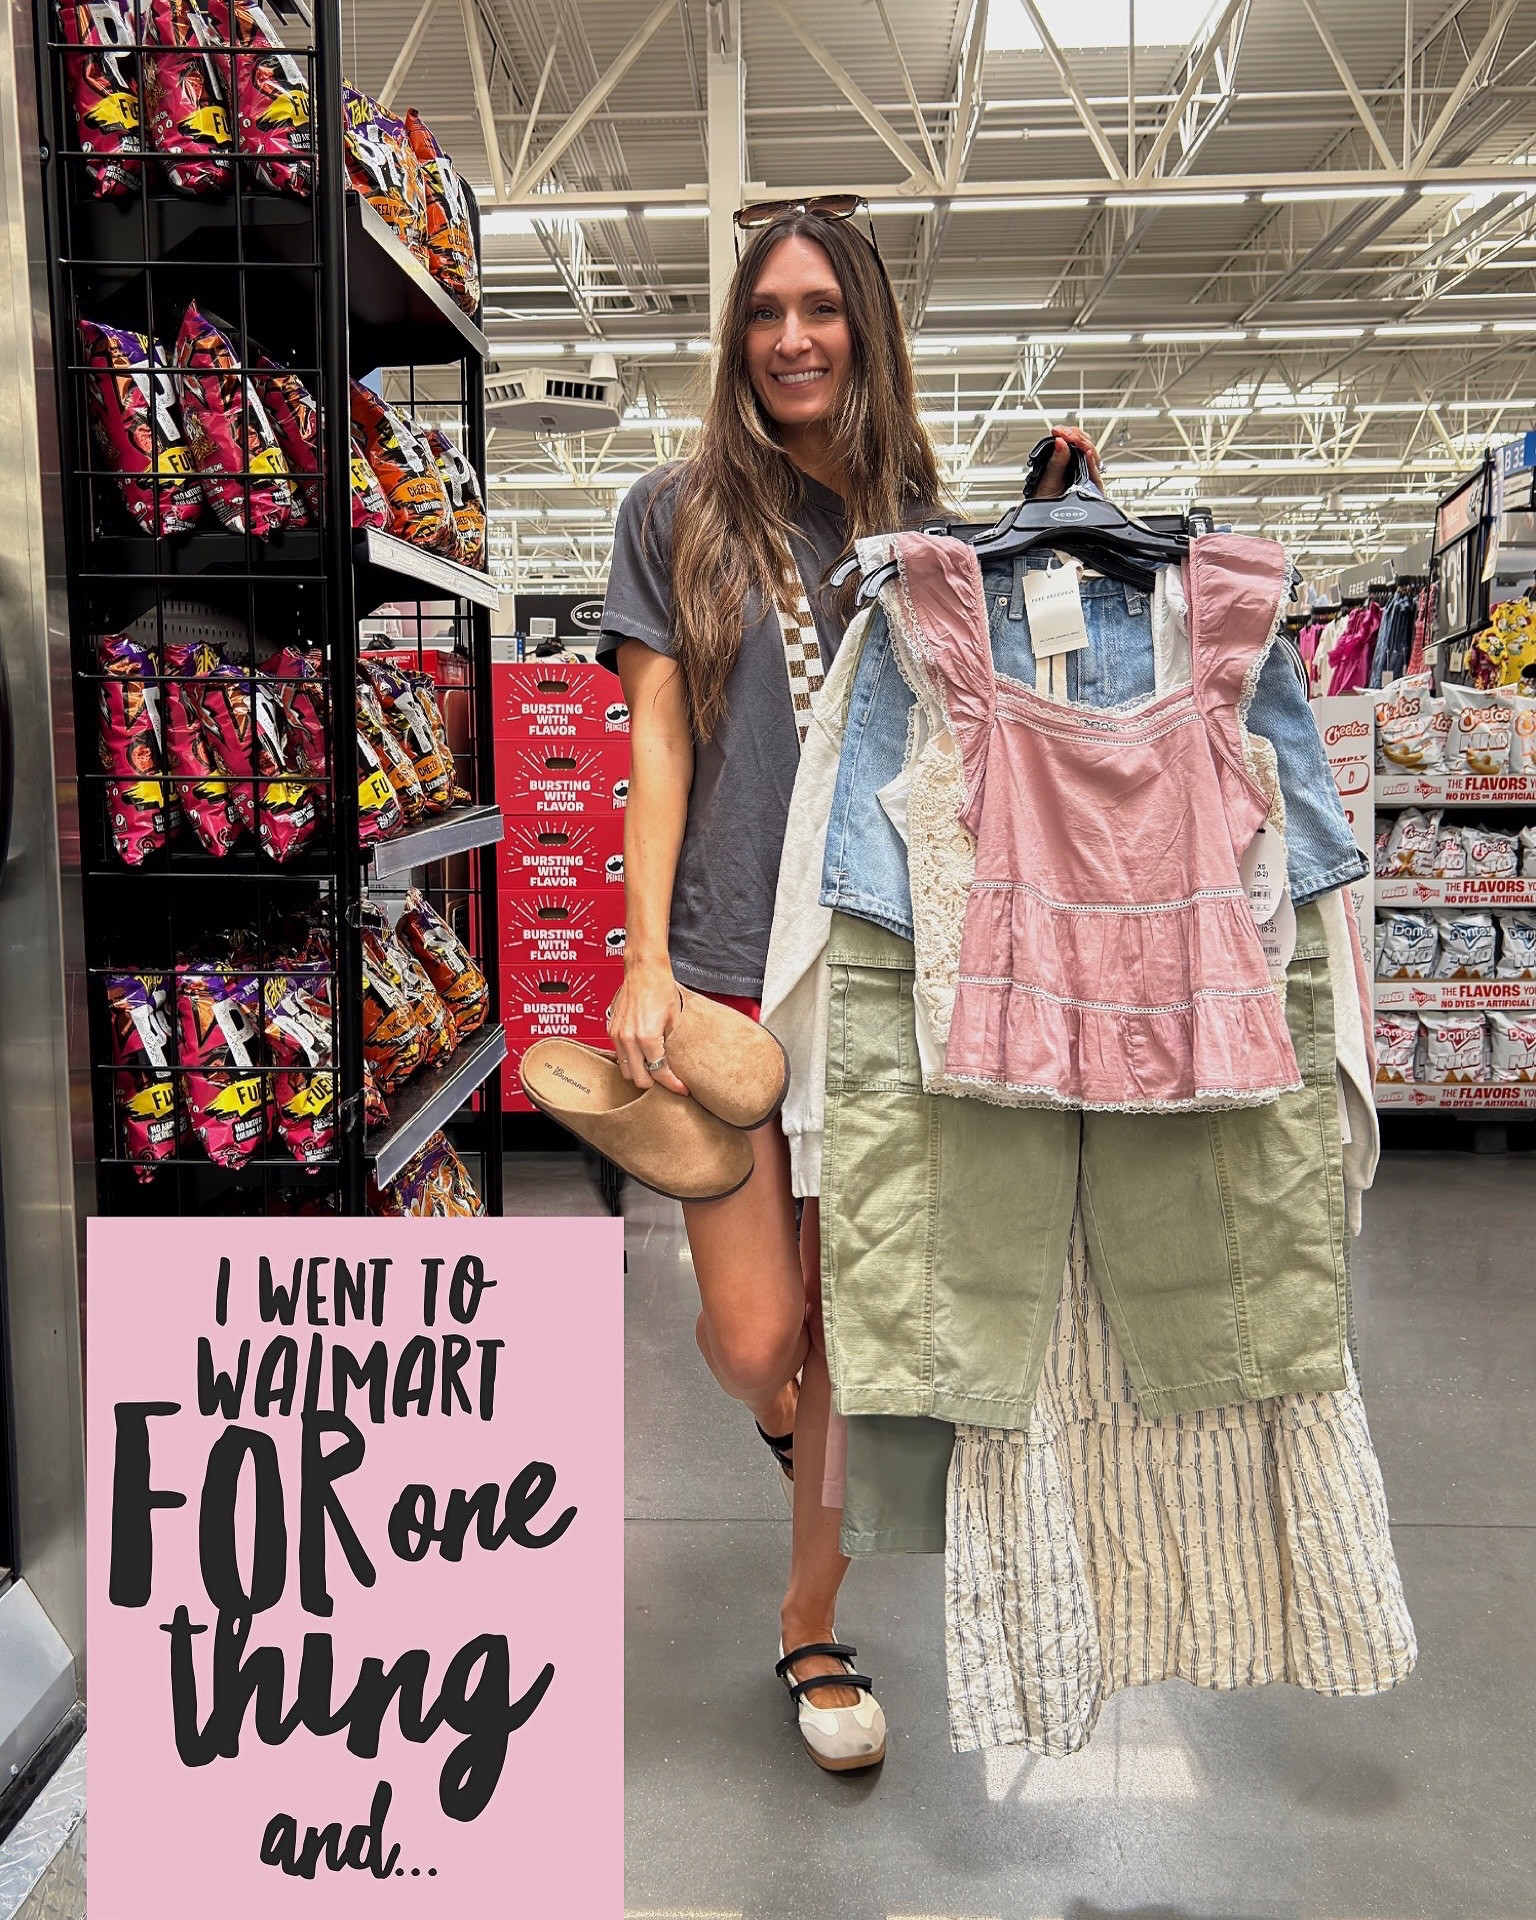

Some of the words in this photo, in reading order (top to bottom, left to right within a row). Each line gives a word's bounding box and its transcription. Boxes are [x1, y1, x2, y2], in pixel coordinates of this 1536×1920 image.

[521, 703, 583, 715] BURSTING
[536, 714, 568, 725] WITH
[1459, 704, 1512, 733] Cheetos
[528, 726, 577, 736] FLAVOR
[605, 722, 630, 734] PRINGLES
[1325, 721, 1369, 746] Cheetos
[529, 780, 591, 791] BURSTING
[1447, 778, 1463, 789] THE
[1465, 778, 1527, 790] FLAVORS
[544, 792, 576, 801] WITH
[1446, 792, 1457, 800] NO
[1459, 792, 1480, 800] DYES
[536, 802, 584, 812] FLAVOR
[522, 856, 584, 866] BURSTING
[537, 867, 569, 877] WITH
[1254, 870, 1269, 878] (0-2)
[530, 877, 577, 887] FLAVOR
[1446, 882, 1461, 891] THE
[1463, 880, 1525, 893] FLAVORS
[1444, 895, 1456, 904] NO
[1458, 895, 1480, 904] DYES
[1490, 894, 1534, 904] ARTIFICIAL
[522, 930, 584, 940] BURSTING
[1262, 926, 1276, 934] (0-2)
[538, 940, 569, 950] WITH
[530, 950, 577, 961] FLAVOR
[1442, 987, 1457, 996] THE
[1460, 984, 1521, 998] FLAVORS
[523, 1003, 584, 1014] BURSTING
[1441, 1000, 1453, 1008] NO
[1454, 1000, 1476, 1008] DYES
[1486, 999, 1530, 1008] ARTIFICIAL
[538, 1014, 570, 1024] WITH
[530, 1024, 578, 1035] FLAVOR
[1437, 1027, 1481, 1040] Doritos
[1436, 1050, 1481, 1071] NKD
[1442, 1088, 1457, 1097] THE
[1459, 1088, 1521, 1099] FLAVORS
[1439, 1100, 1451, 1108] NO
[1453, 1100, 1474, 1108] DYES
[1484, 1100, 1528, 1108] ARTIFICIAL
